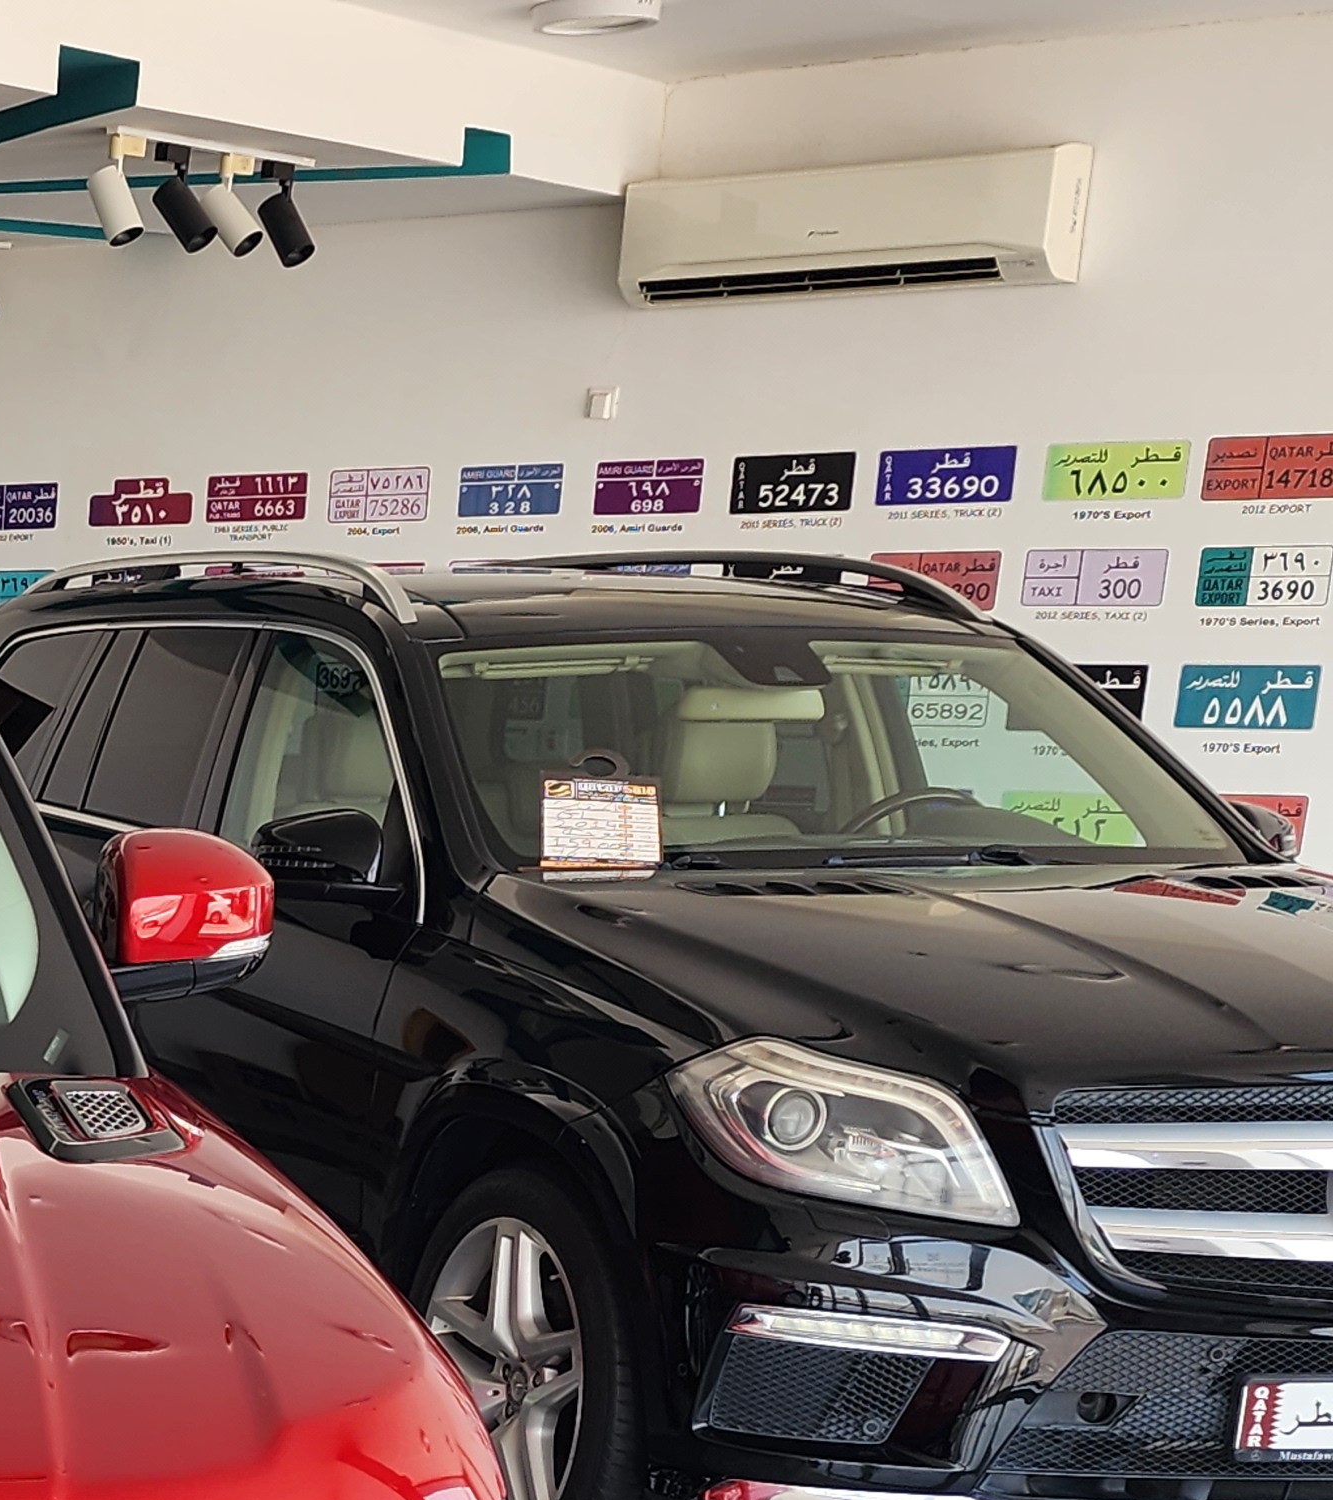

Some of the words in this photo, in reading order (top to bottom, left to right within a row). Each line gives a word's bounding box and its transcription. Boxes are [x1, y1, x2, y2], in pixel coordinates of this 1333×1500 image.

[1130, 446, 1182, 469] قطر
[1269, 446, 1314, 460] QATAR
[779, 458, 816, 482] قطر
[931, 452, 971, 473] قطر
[112, 481, 165, 505] قطر
[906, 475, 1000, 499] 33690
[1206, 478, 1258, 491] EXPORT
[6, 490, 32, 503] QATAR
[758, 483, 840, 508] 52473
[210, 501, 240, 512] QATAR
[254, 500, 295, 517] 6663
[369, 498, 421, 517] 75286
[631, 499, 664, 513] 698
[954, 508, 985, 518] TRUCK
[1242, 504, 1266, 514] 2012
[1269, 504, 1312, 514] EXPORT
[8, 507, 53, 524] 20036
[1113, 510, 1151, 521] Export
[923, 561, 960, 576] QATAR
[962, 558, 996, 576] قطر
[1038, 555, 1067, 572] أجرة
[1103, 556, 1140, 574] قطر
[1031, 586, 1063, 597] TAXI
[1098, 578, 1142, 600] 300
[1203, 578, 1243, 591] QATAR
[1257, 580, 1315, 601] 3690
[1035, 611, 1059, 620] 2012
[1104, 611, 1130, 620] TAXI
[1240, 617, 1279, 627] Series,
[1282, 617, 1320, 628] Export
[1261, 670, 1314, 694] قطر
[911, 703, 984, 721] 65892
[1202, 695, 1287, 727] ٥٥٨٨
[941, 738, 980, 749] Export
[1243, 743, 1281, 755] Export
[1246, 1385, 1271, 1448] QATAR
[1279, 1400, 1333, 1435] طر
[1278, 1450, 1333, 1461] Mustafaw
